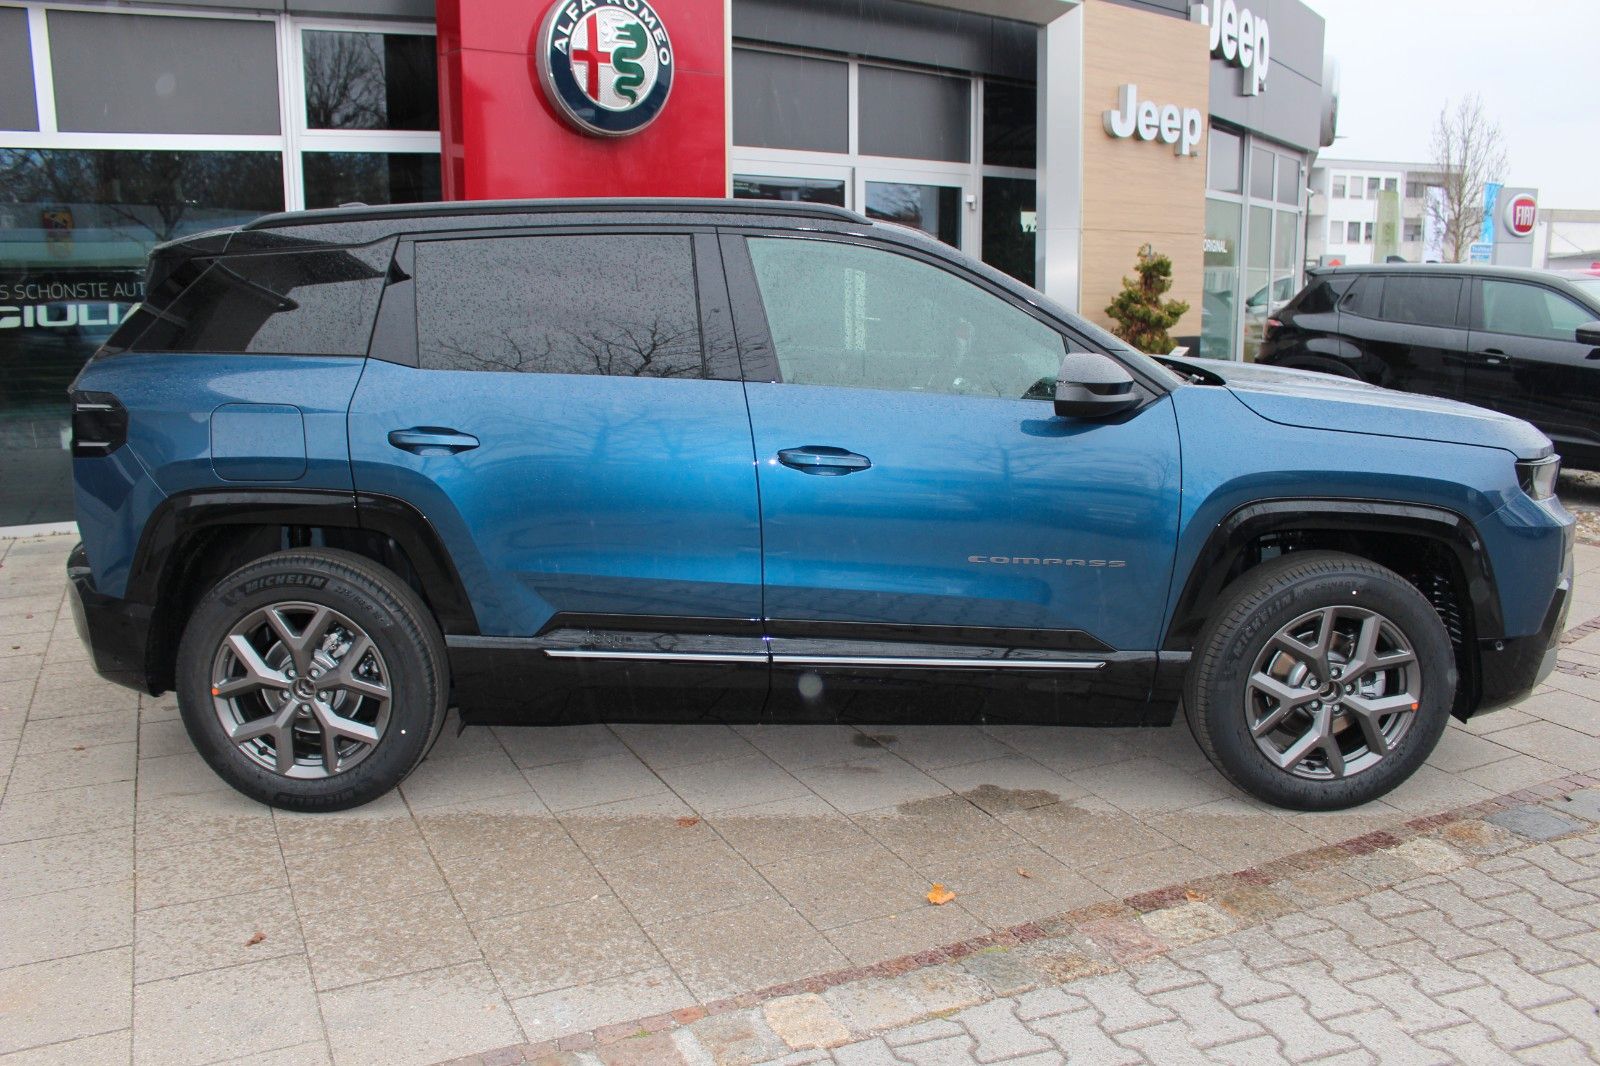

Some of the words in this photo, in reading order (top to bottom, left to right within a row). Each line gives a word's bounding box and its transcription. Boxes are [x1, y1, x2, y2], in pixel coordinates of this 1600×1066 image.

[554, 0, 596, 55] ALFA
[1105, 83, 1202, 156] Jeep
[1515, 205, 1536, 225] FIAT
[15, 282, 108, 300] SCHÖNSTE
[113, 282, 147, 297] AUT
[967, 555, 1128, 568] COMPASS
[244, 574, 327, 593] MICHELIN
